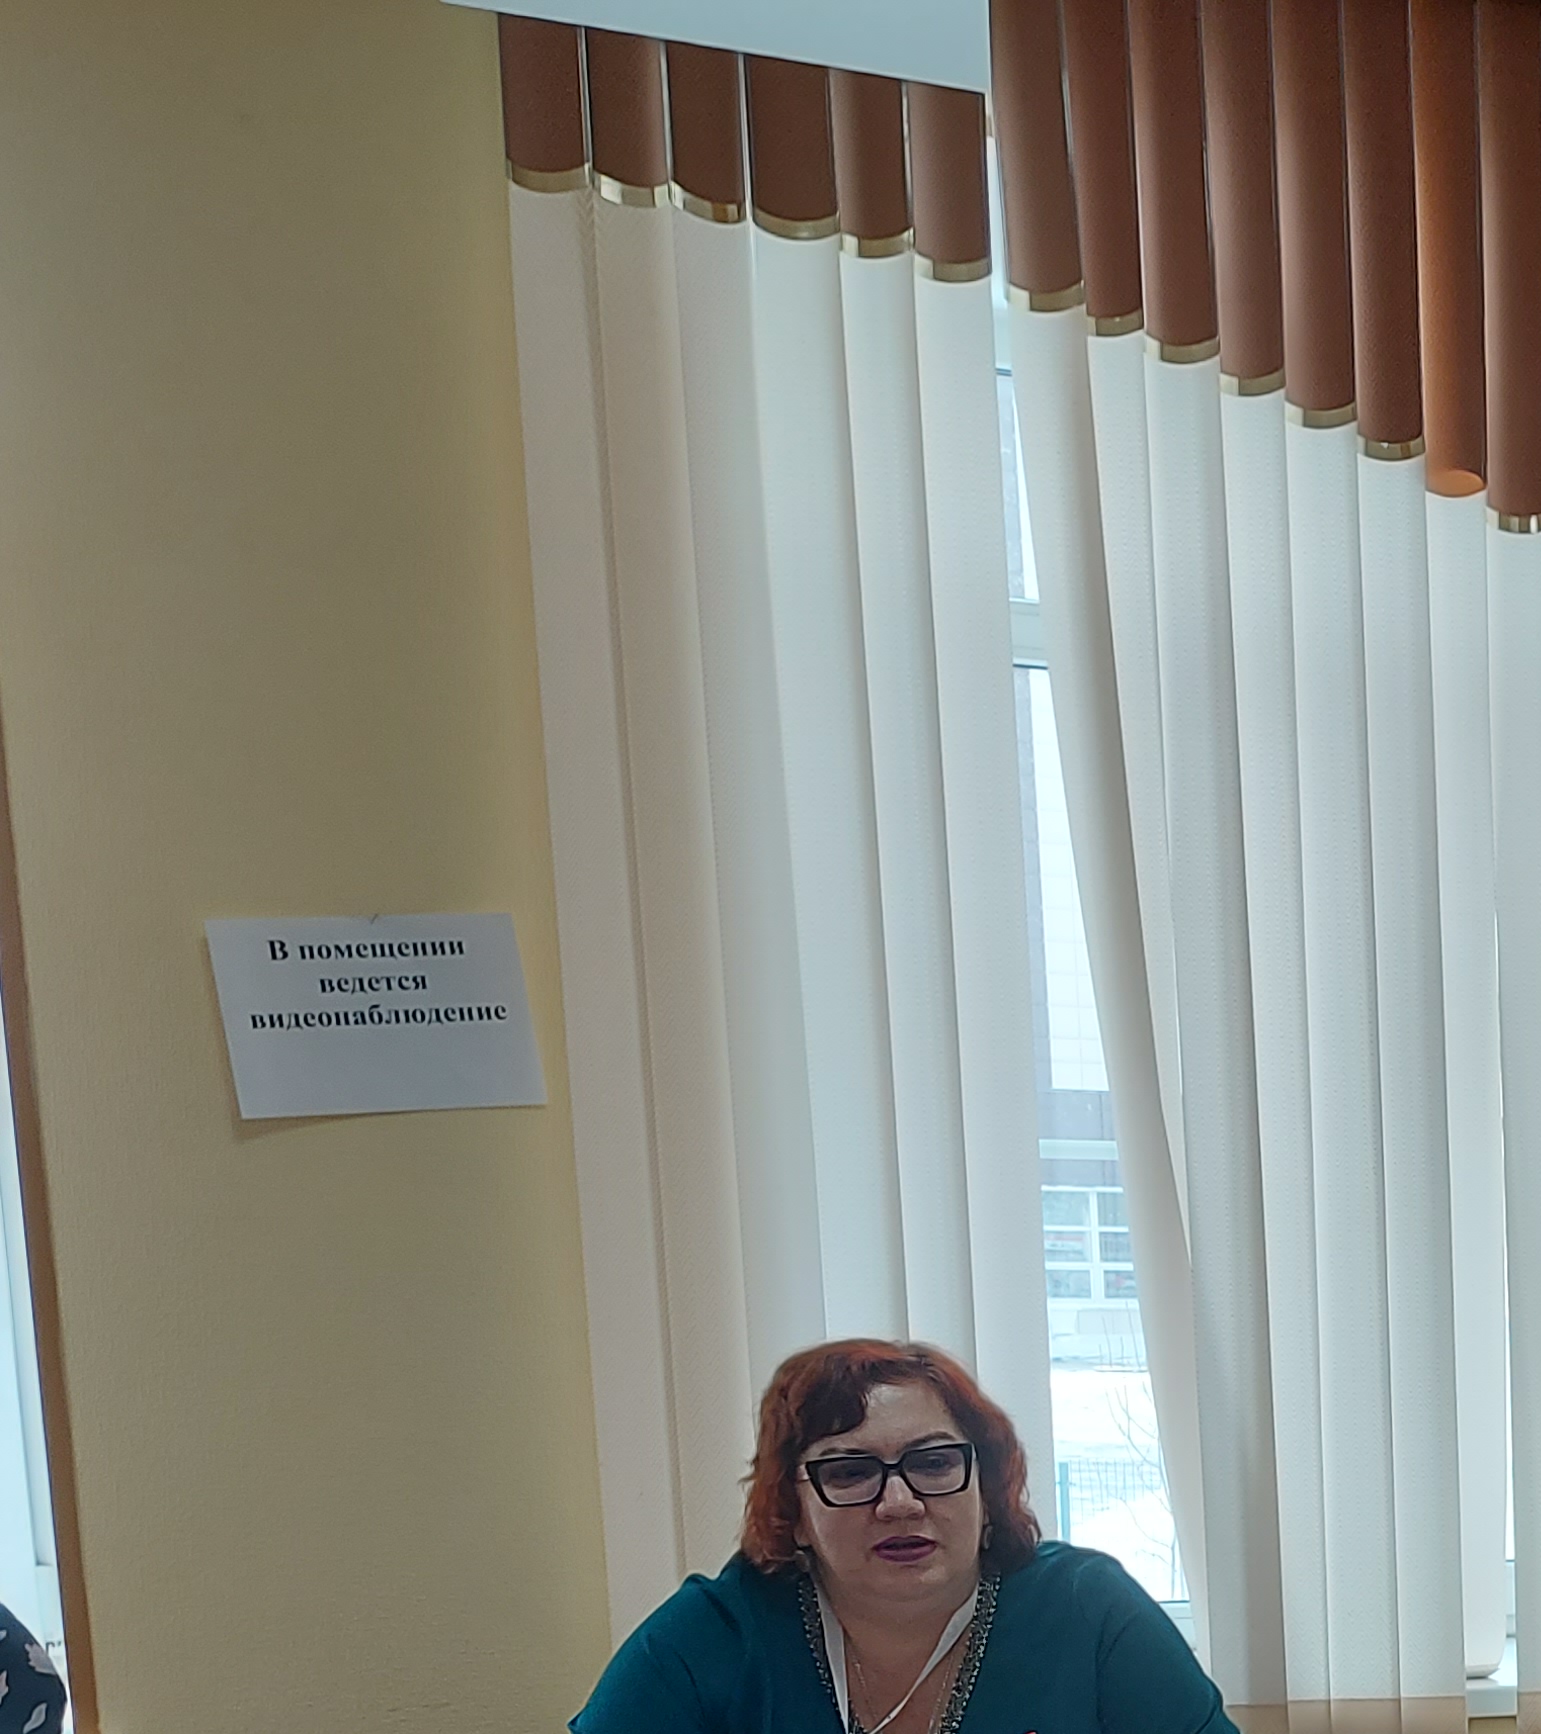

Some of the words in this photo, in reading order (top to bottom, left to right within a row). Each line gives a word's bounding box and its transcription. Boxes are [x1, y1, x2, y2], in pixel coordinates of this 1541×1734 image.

[267, 939, 289, 962] В
[298, 939, 466, 962] помещении
[319, 974, 429, 996] ведется
[250, 1004, 509, 1032] видеонаблюдение
